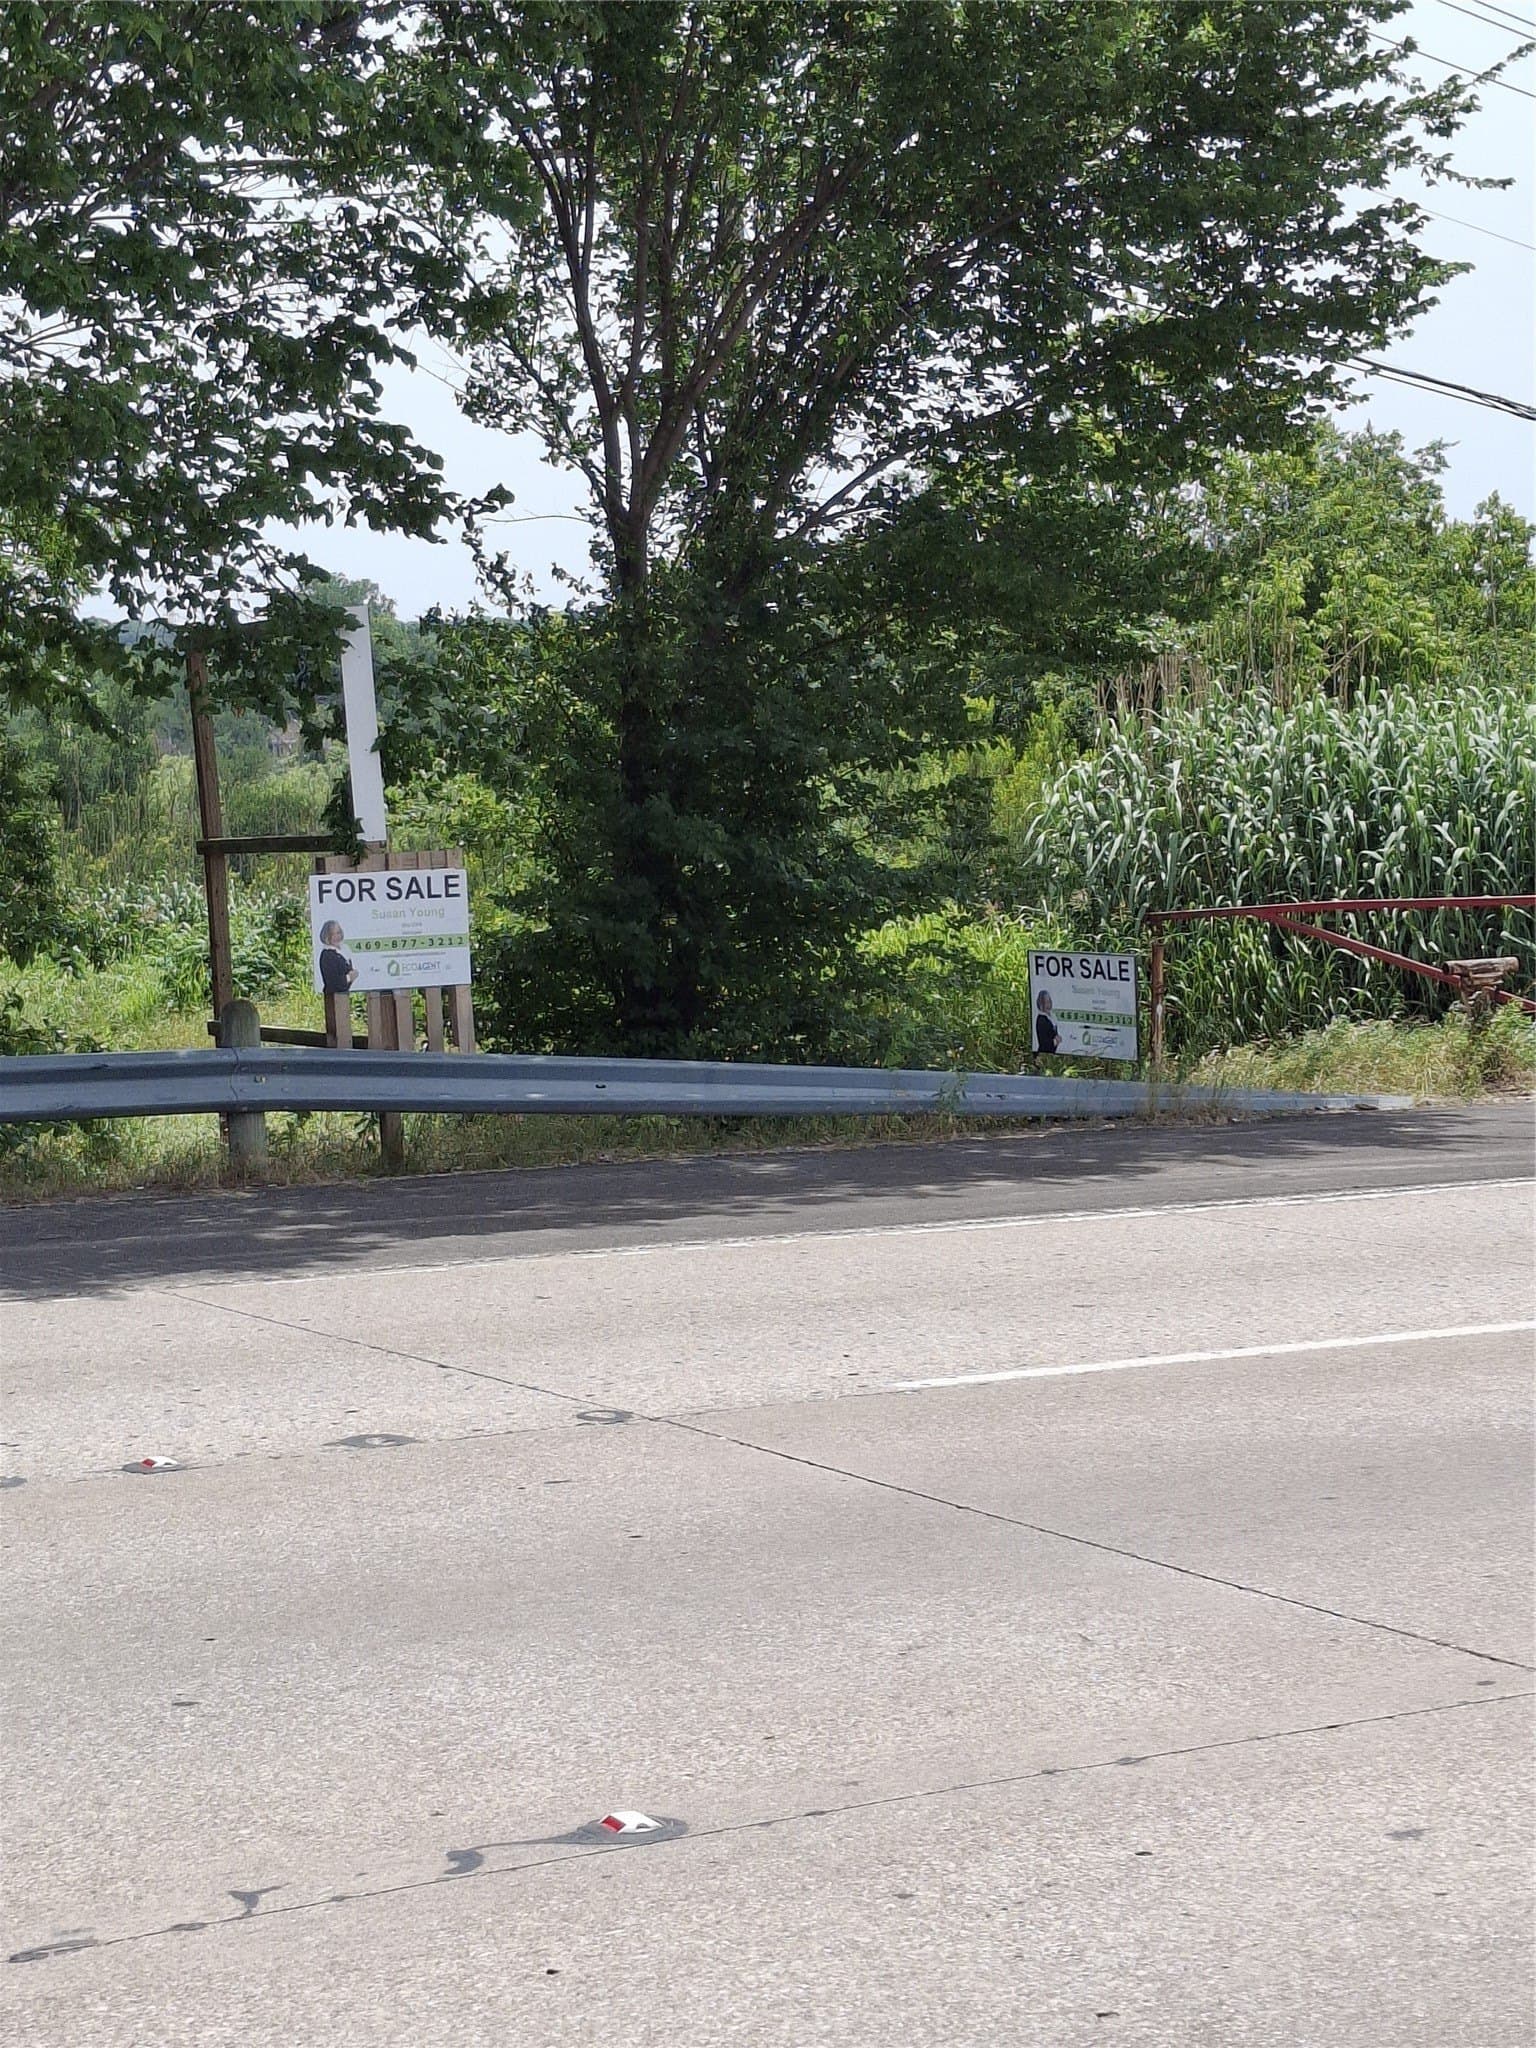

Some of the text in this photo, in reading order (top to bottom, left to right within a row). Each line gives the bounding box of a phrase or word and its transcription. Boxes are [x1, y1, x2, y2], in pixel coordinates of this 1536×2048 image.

[318, 875, 461, 904] FOR SALE
[371, 907, 445, 920] Susan Young
[355, 936, 464, 950] 469-877-3212
[1035, 955, 1130, 982] FOR SALE
